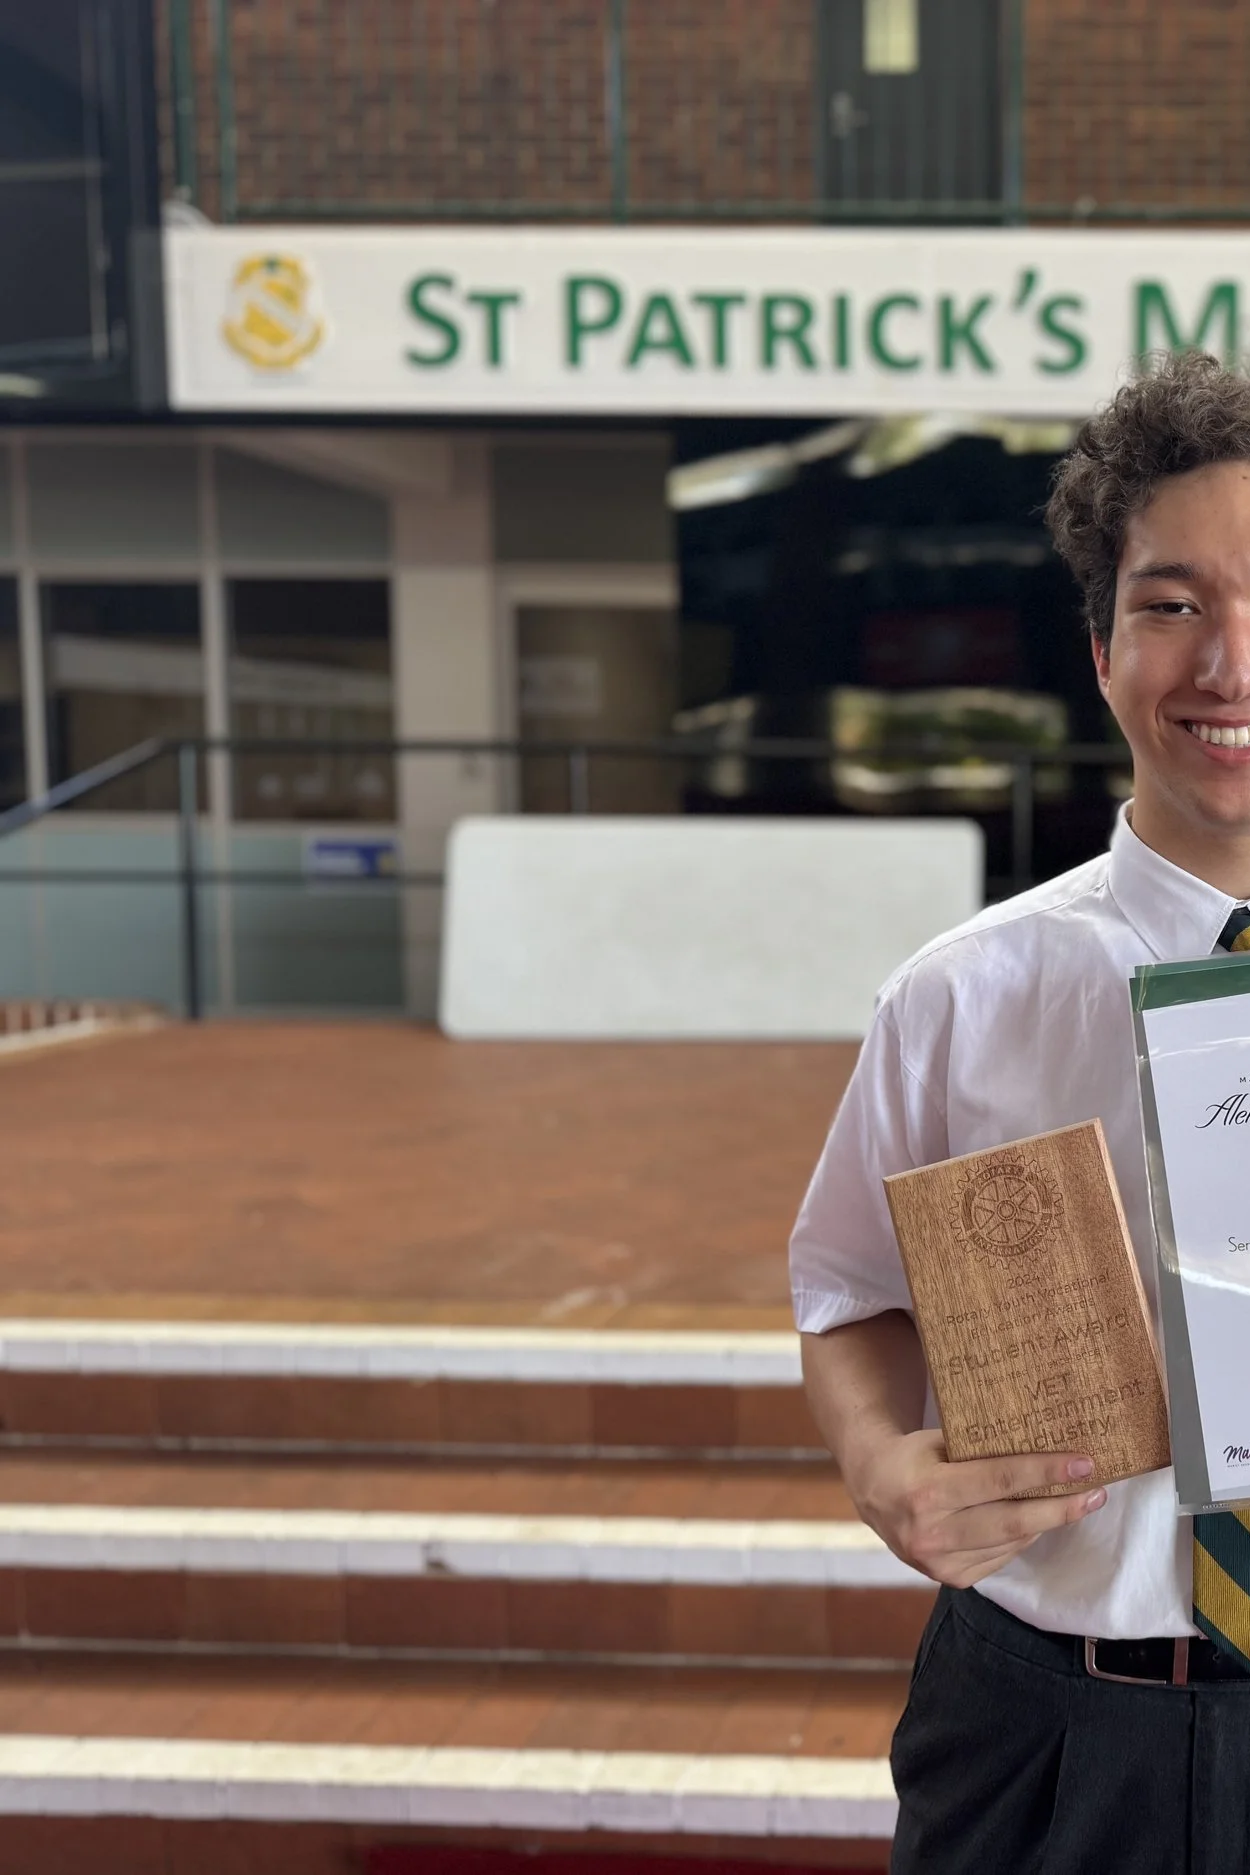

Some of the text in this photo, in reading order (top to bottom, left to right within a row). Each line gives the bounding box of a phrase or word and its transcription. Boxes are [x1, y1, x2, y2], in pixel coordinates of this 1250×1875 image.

[1007, 1273, 1041, 1290] 2024
[1052, 1307, 1131, 1350] Award
[1024, 1372, 1072, 1401] VET
